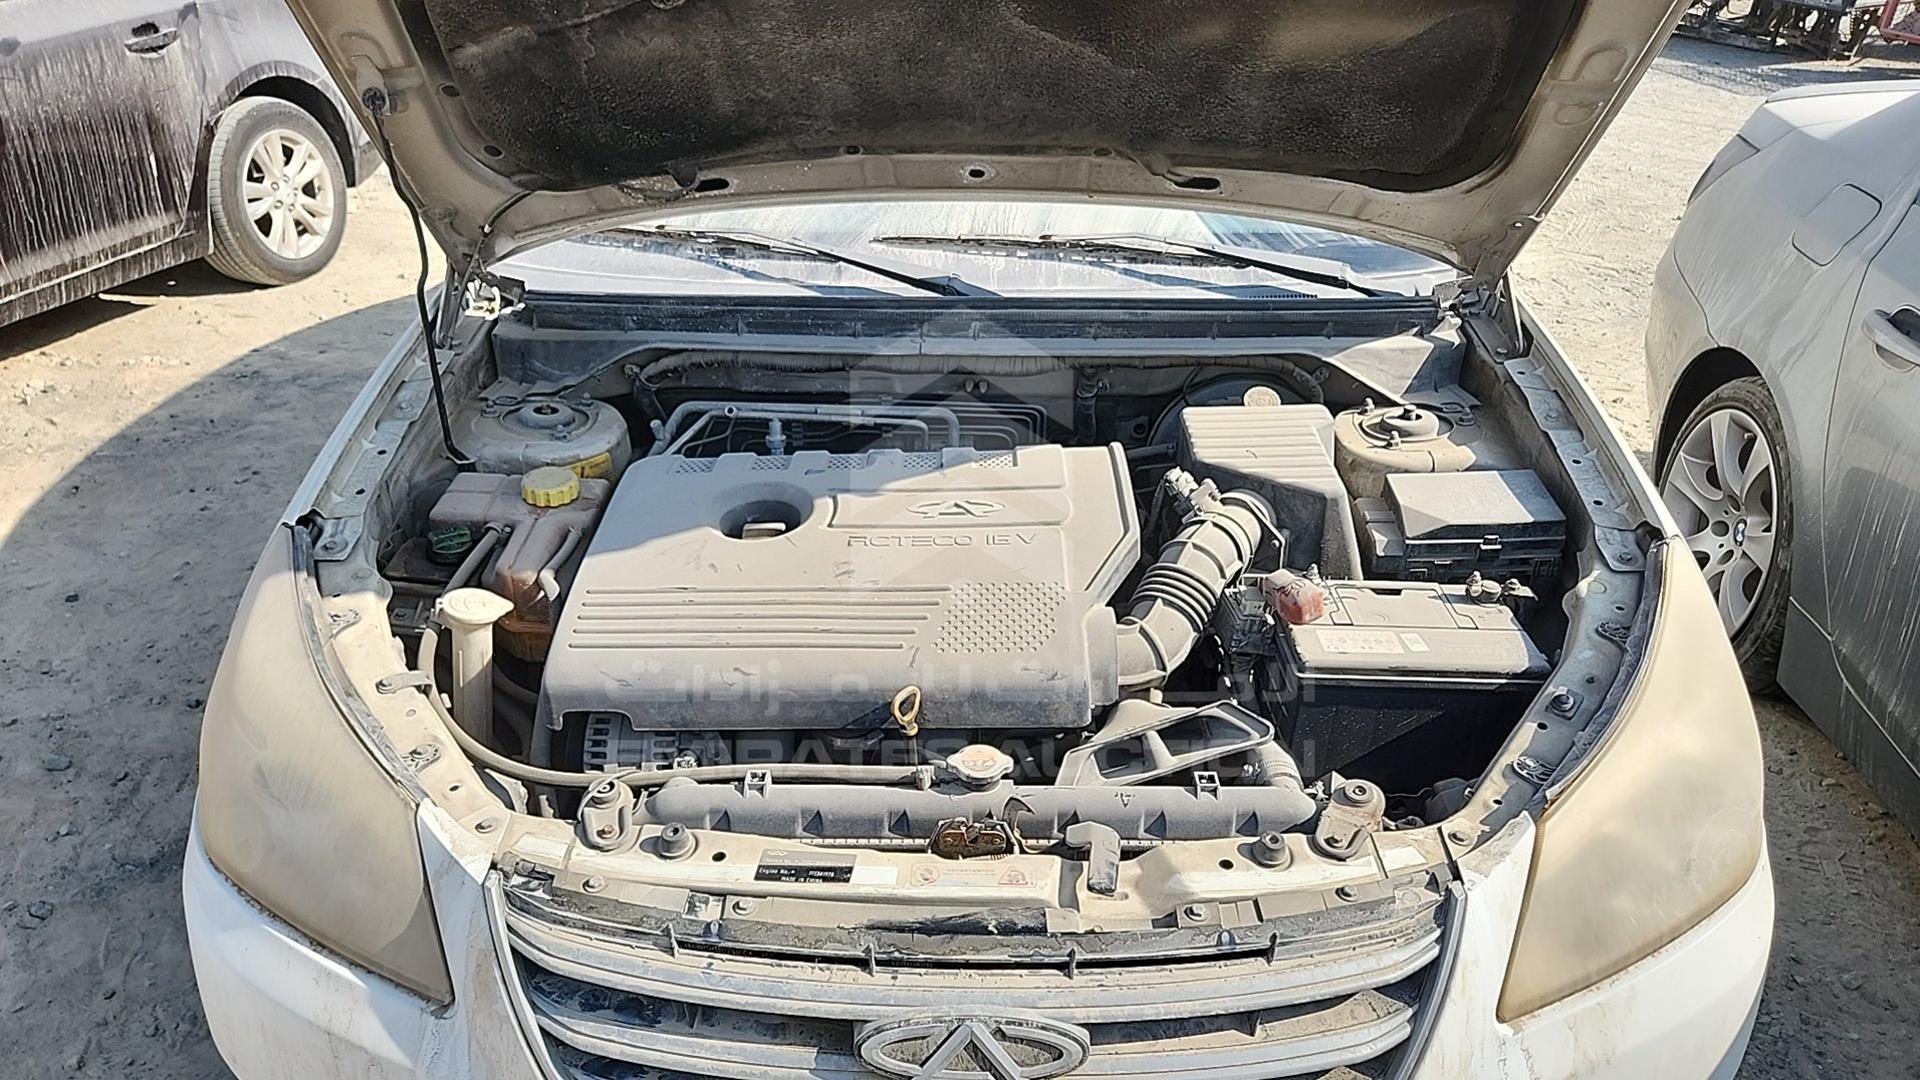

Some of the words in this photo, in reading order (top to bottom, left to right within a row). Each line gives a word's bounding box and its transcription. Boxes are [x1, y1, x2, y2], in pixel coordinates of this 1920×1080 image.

[847, 535, 973, 547] ACTECO
[758, 867, 778, 876] Engine
[780, 875, 796, 883] MADE
